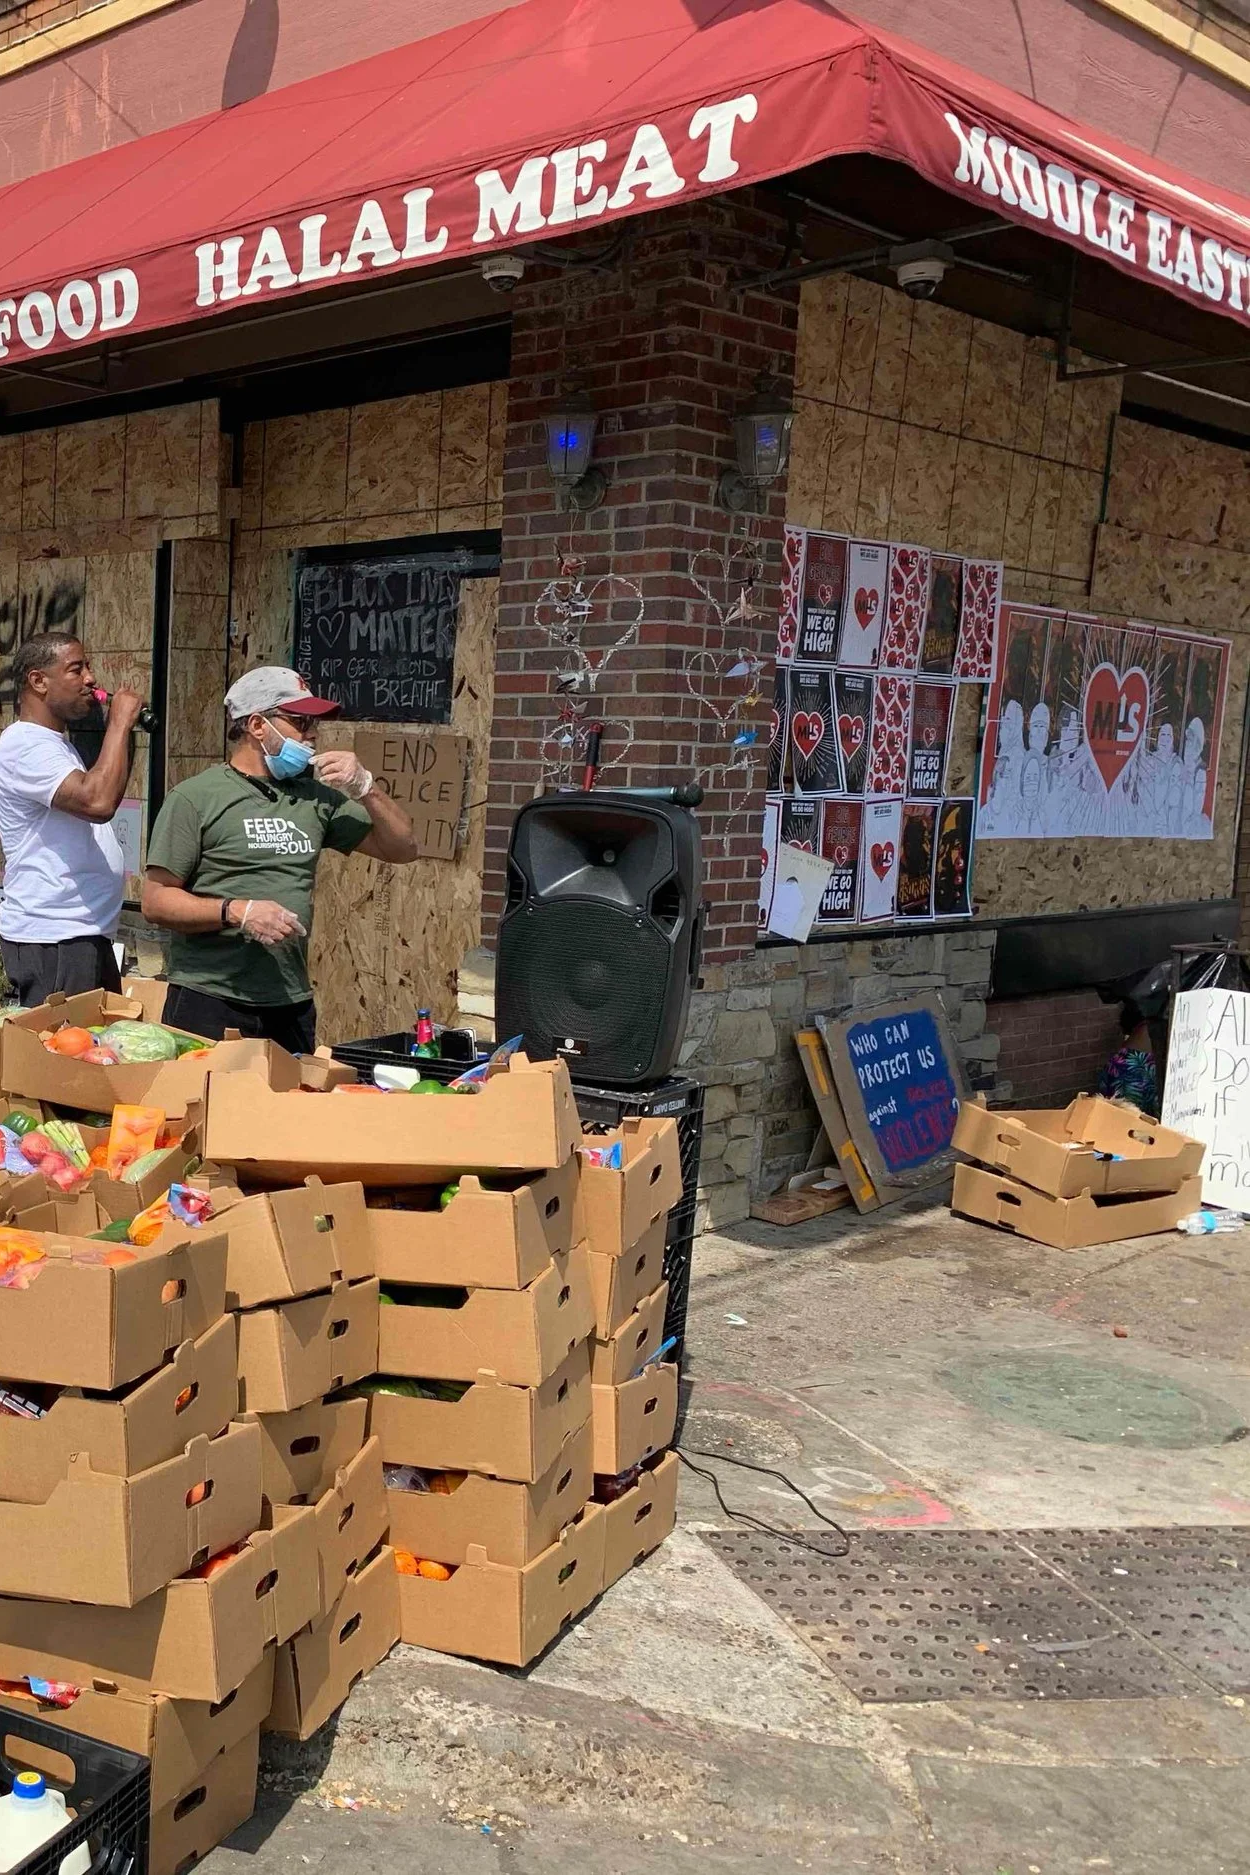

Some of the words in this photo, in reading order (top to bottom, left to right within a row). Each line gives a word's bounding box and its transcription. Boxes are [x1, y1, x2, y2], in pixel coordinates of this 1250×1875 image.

[194, 187, 449, 307] HALAL
[472, 93, 758, 243] MEAT
[944, 112, 1136, 263] MIDDLE
[1147, 210, 1250, 316] EAST
[313, 574, 394, 614] BLACK
[406, 569, 458, 606] LIVES
[350, 605, 456, 659] MATTER
[807, 614, 824, 630] WE
[823, 616, 836, 631] GO
[803, 631, 833, 653] HIGH
[321, 658, 343, 678] RIP
[382, 740, 437, 775] END
[914, 755, 926, 769] WE
[927, 757, 939, 770] GO
[375, 777, 454, 803] OLICE
[912, 772, 938, 790] HIGH
[243, 818, 287, 834] FEED
[256, 832, 293, 842] HUNGRY
[280, 840, 316, 854] SOUL
[840, 876, 852, 890] GO
[823, 892, 850, 910] HIGH
[1214, 994, 1250, 1047] AL
[850, 1033, 878, 1057] WHO
[884, 1020, 910, 1046] CAN
[858, 1051, 910, 1089] PROTECT
[917, 1045, 935, 1070] US
[869, 1096, 898, 1126] against
